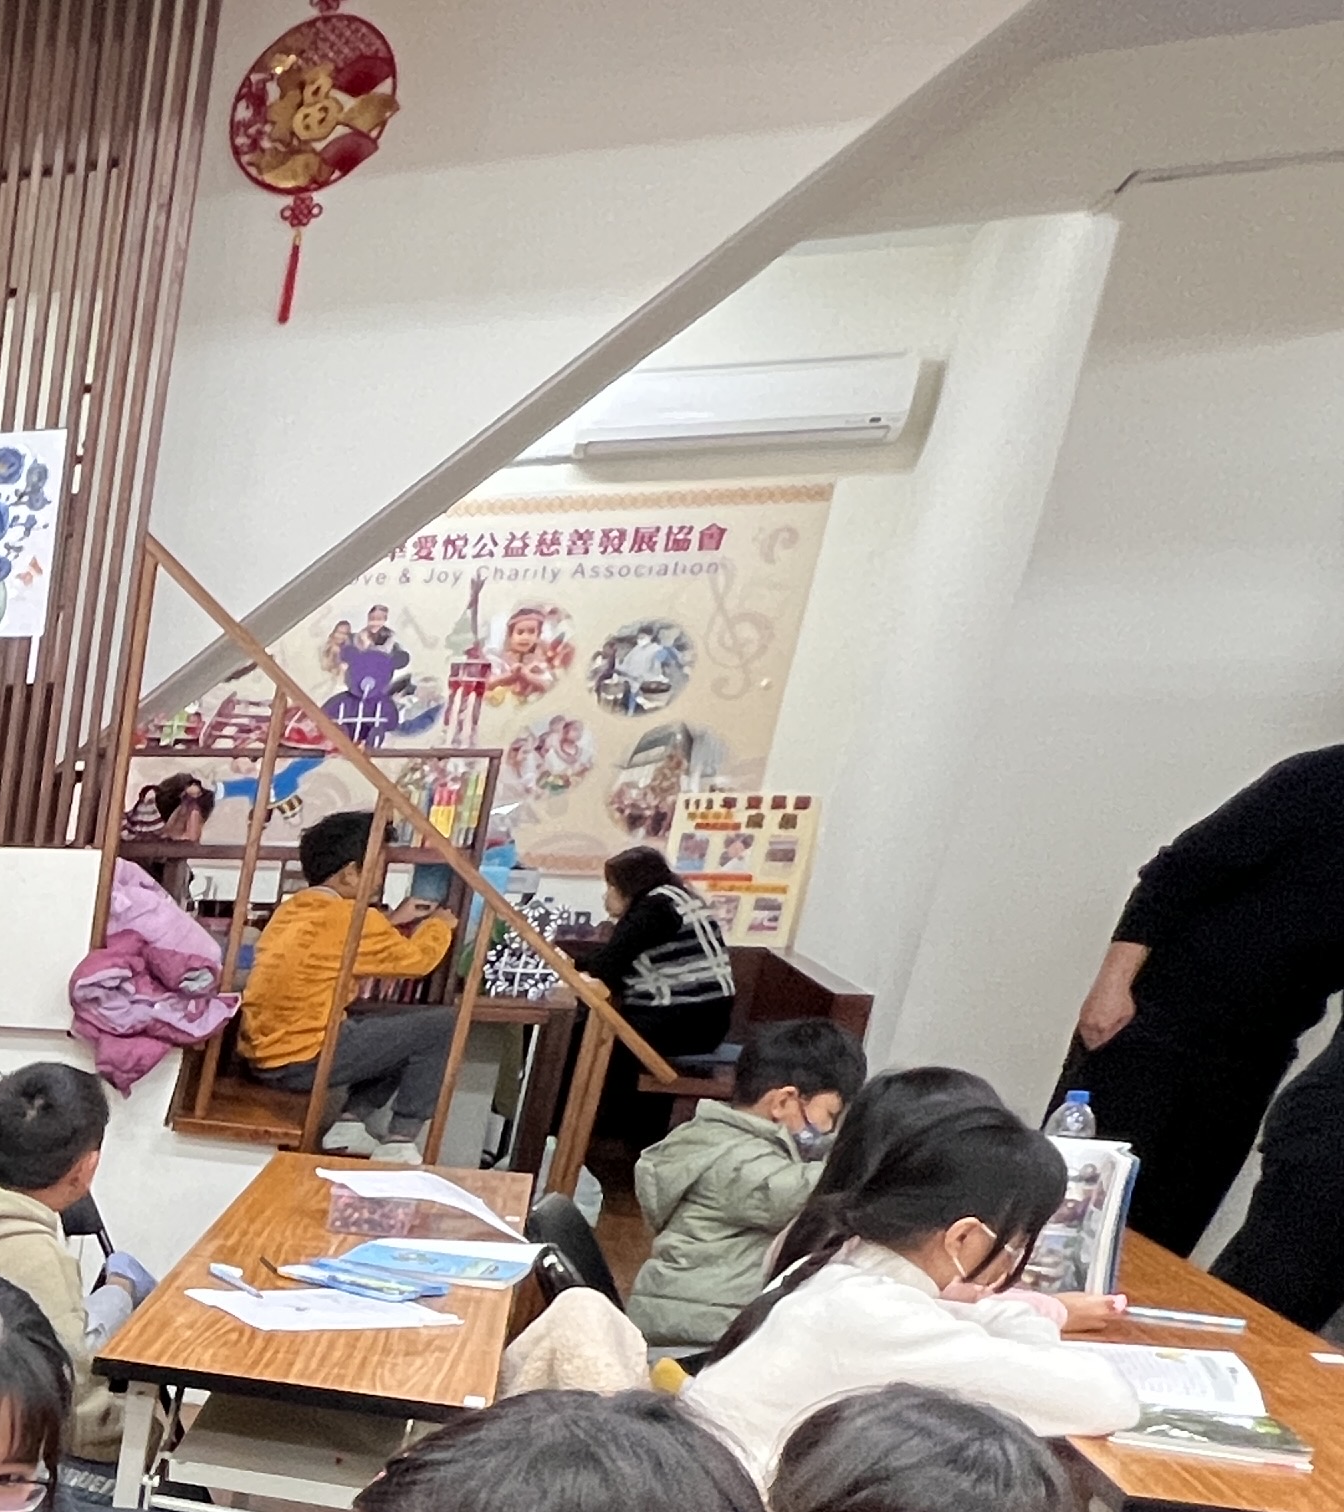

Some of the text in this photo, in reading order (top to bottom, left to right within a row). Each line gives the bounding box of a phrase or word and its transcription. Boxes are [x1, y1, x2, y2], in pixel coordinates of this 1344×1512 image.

[398, 567, 411, 585] &
[423, 567, 464, 587] Joy
[475, 563, 562, 584] Charity
[572, 560, 720, 580] Association
